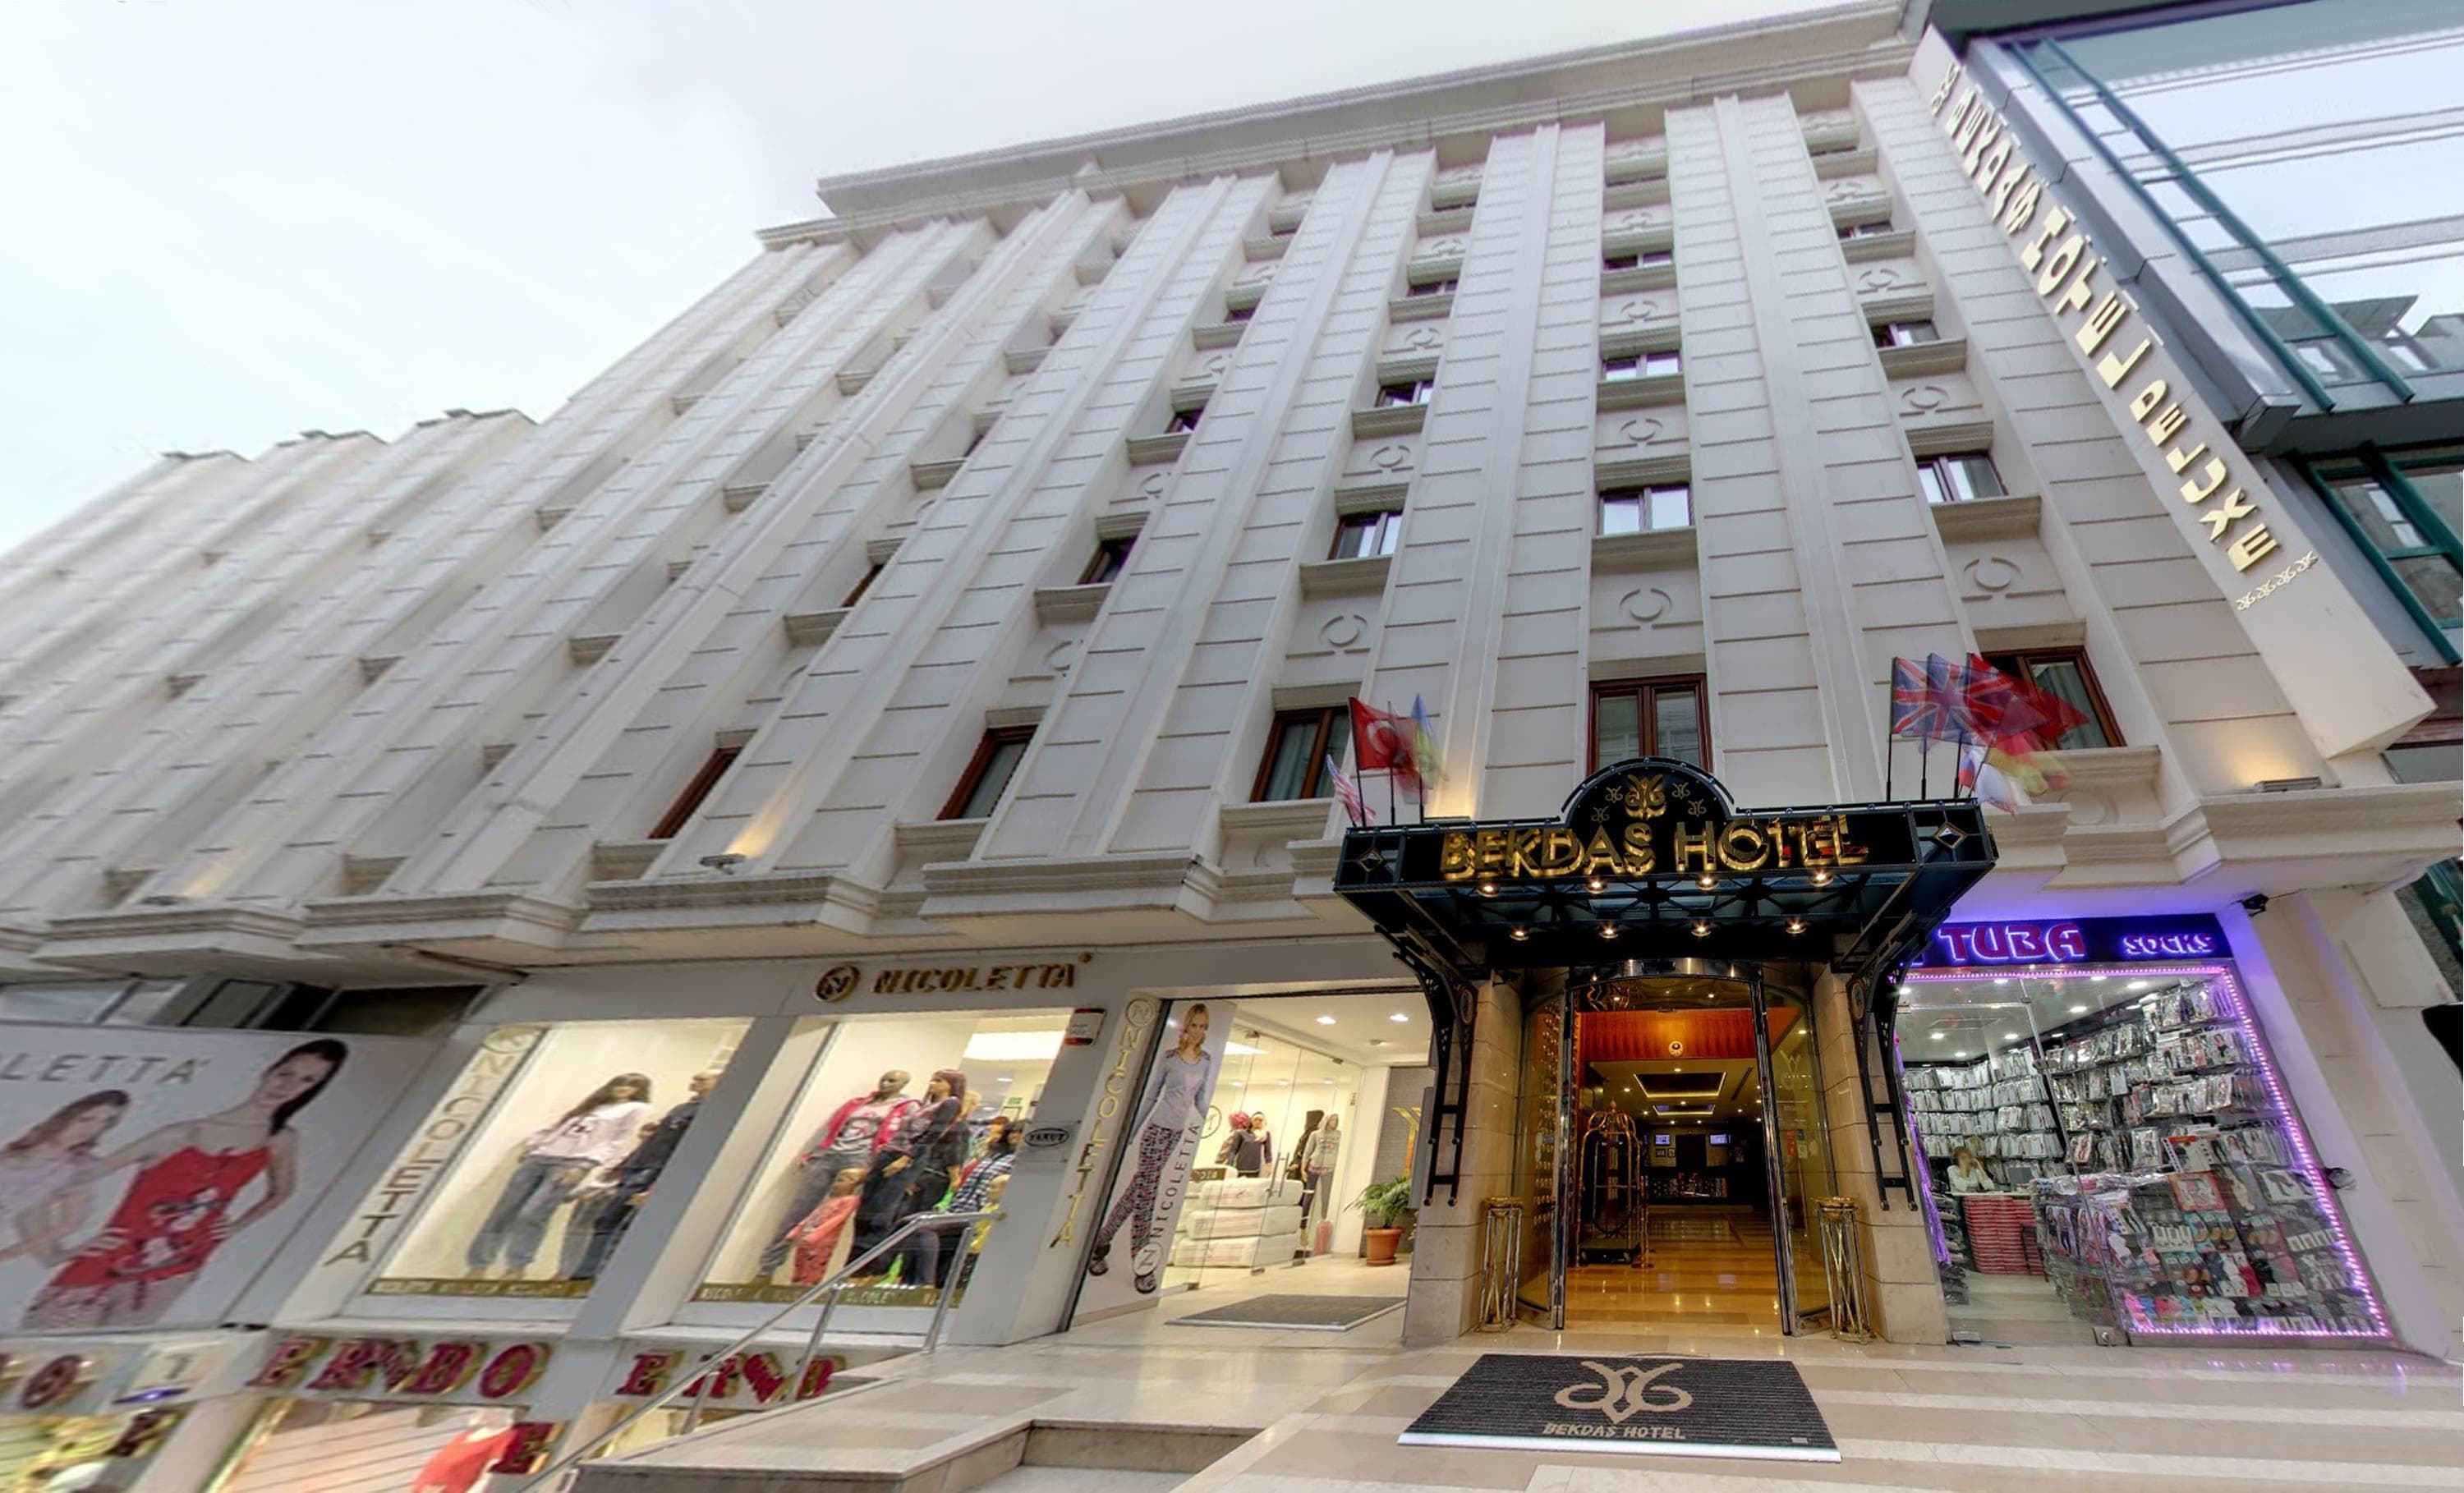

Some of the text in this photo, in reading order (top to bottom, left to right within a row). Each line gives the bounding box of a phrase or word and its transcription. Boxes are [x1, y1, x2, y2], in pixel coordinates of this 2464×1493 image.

[2020, 204, 2153, 389] HOTEL
[2129, 379, 2281, 573] DELUXE
[1441, 815, 1869, 880] BEKDAS HOTEL
[1939, 922, 2213, 962] TUBA SOCKS
[871, 962, 1077, 995] NICOLETTA
[1150, 1122, 1201, 1238] NICOLETTA
[1542, 1423, 1685, 1440] BEKDAS HOTEL
